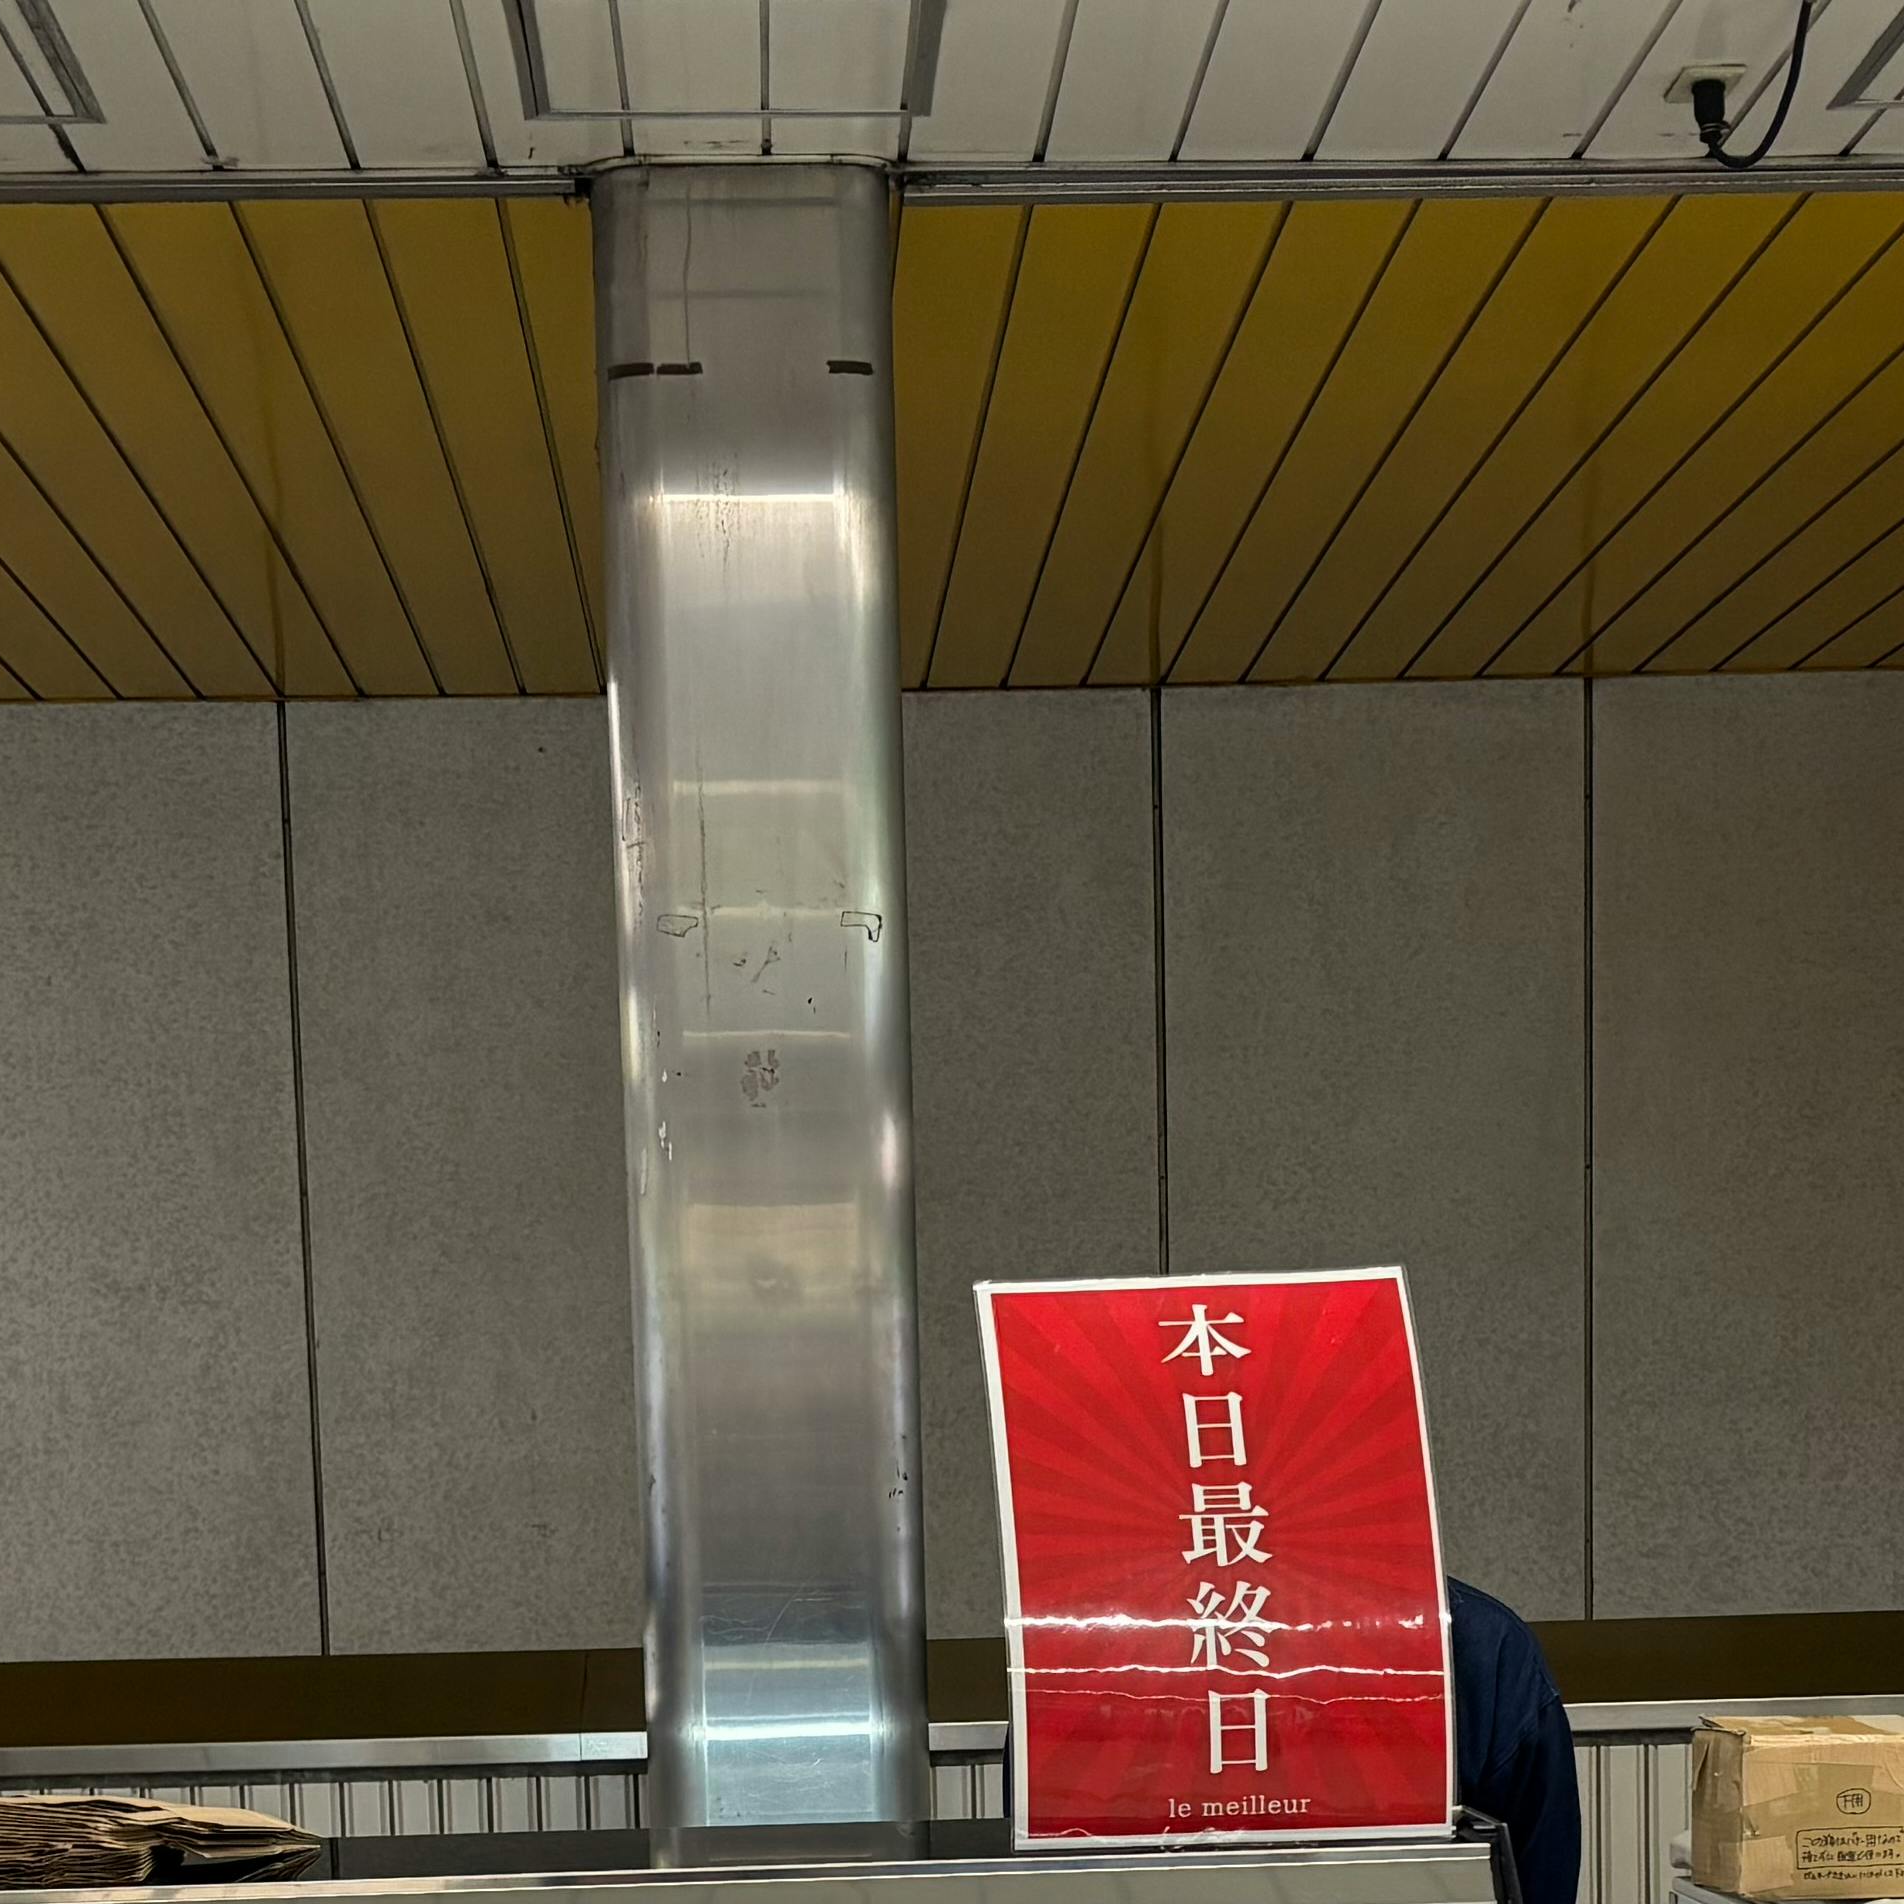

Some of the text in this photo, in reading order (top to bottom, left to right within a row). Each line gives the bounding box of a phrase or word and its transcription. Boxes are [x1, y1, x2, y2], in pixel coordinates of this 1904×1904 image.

[1157, 1303, 1286, 1775] 本日最終日
[1168, 1794, 1311, 1819] le meilleur
